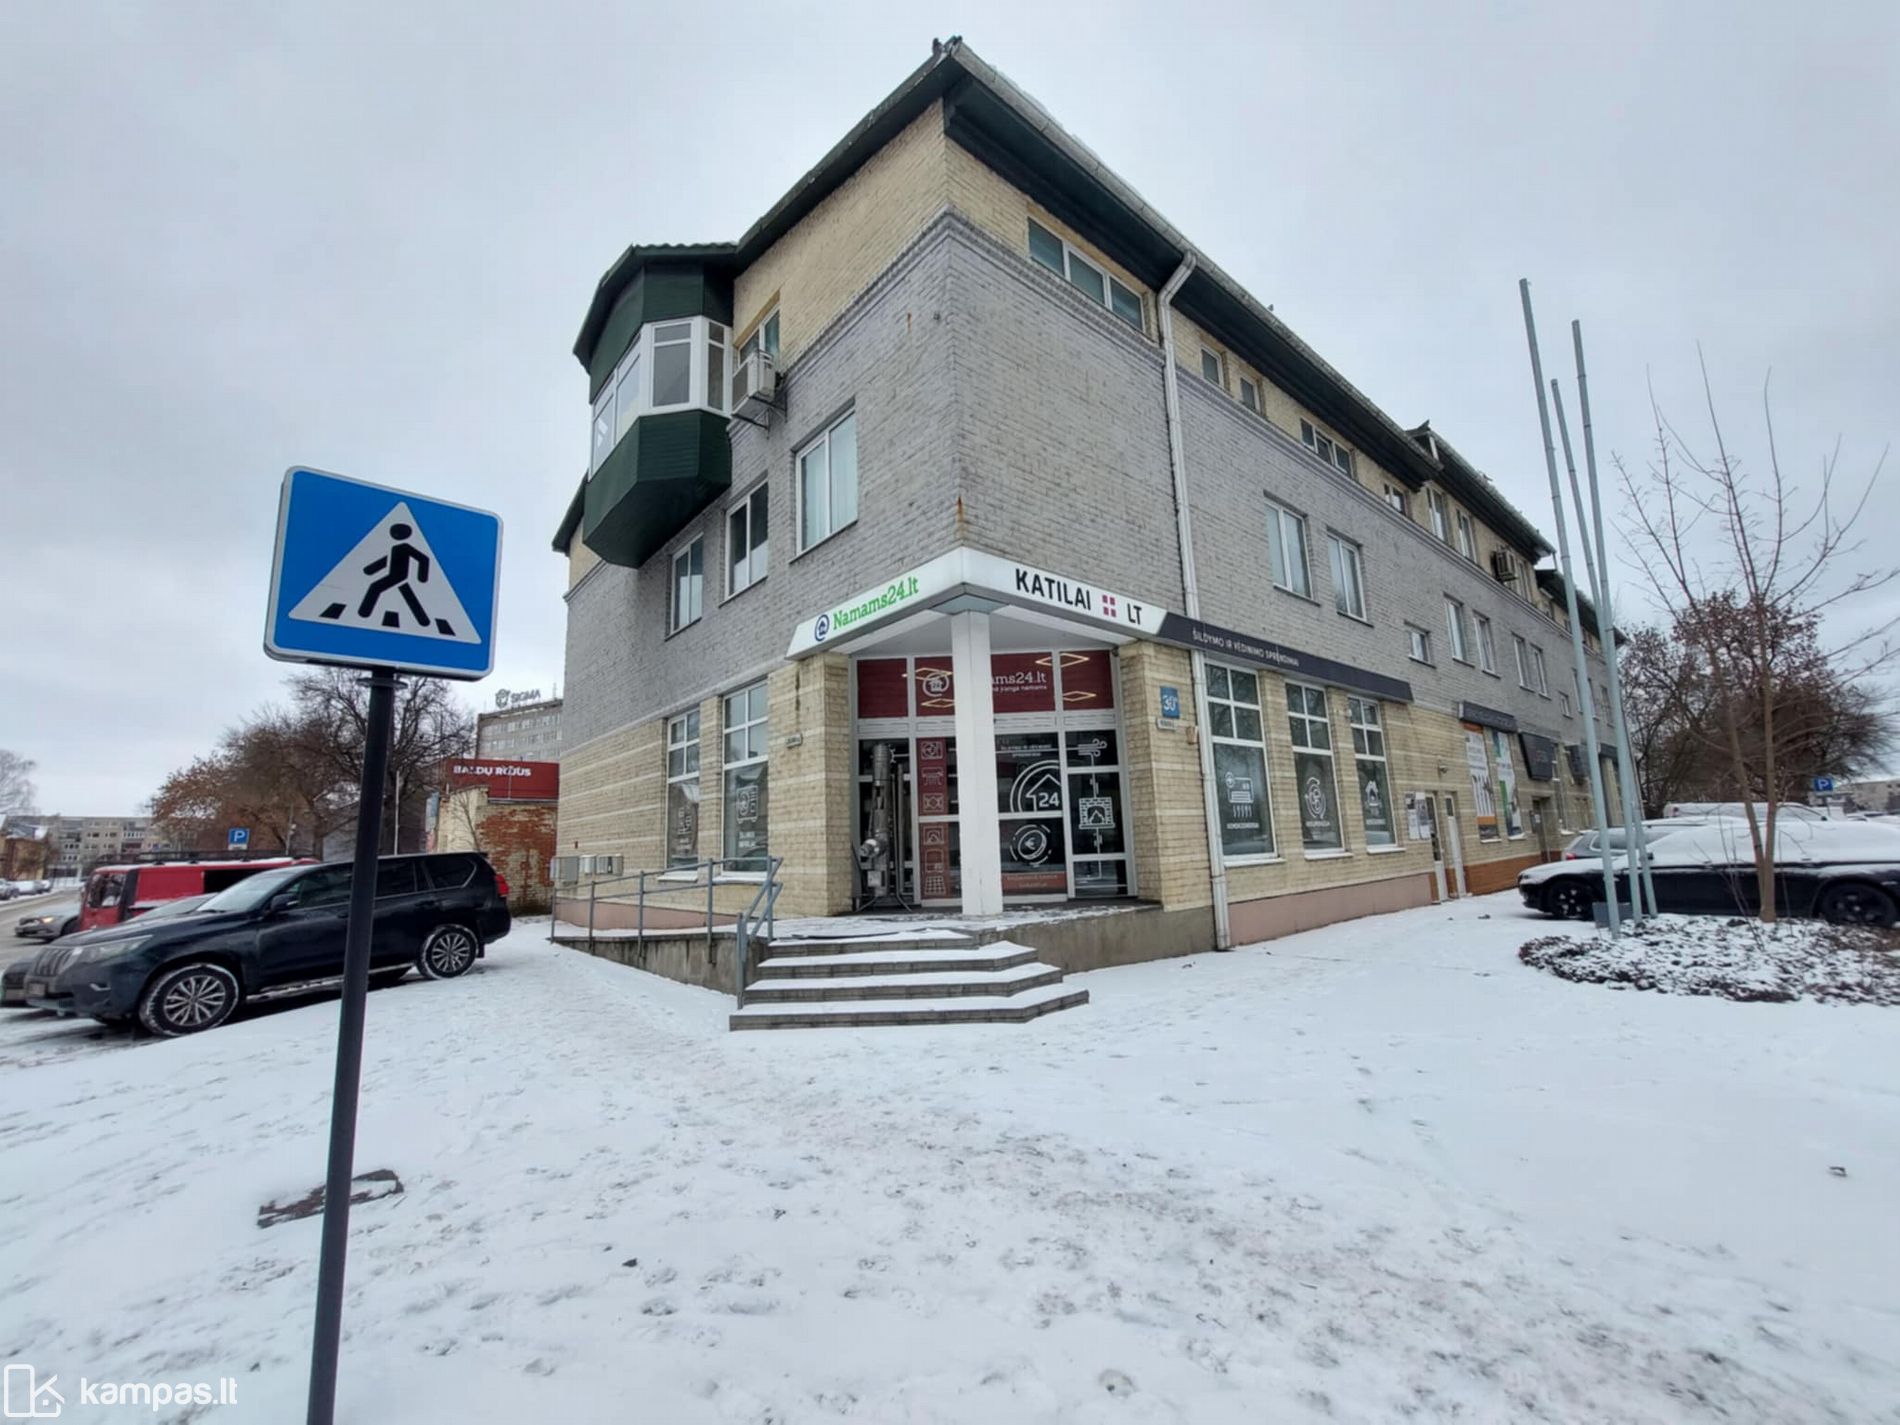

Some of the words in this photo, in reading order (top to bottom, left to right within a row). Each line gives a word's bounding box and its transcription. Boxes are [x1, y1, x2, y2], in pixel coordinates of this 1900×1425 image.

[832, 576, 919, 631] Namams24.lt
[1015, 568, 1092, 611] KATILAI
[1126, 603, 1142, 625] LT
[1817, 779, 1829, 791] P
[1038, 792, 1060, 808] 24
[233, 830, 246, 842] P
